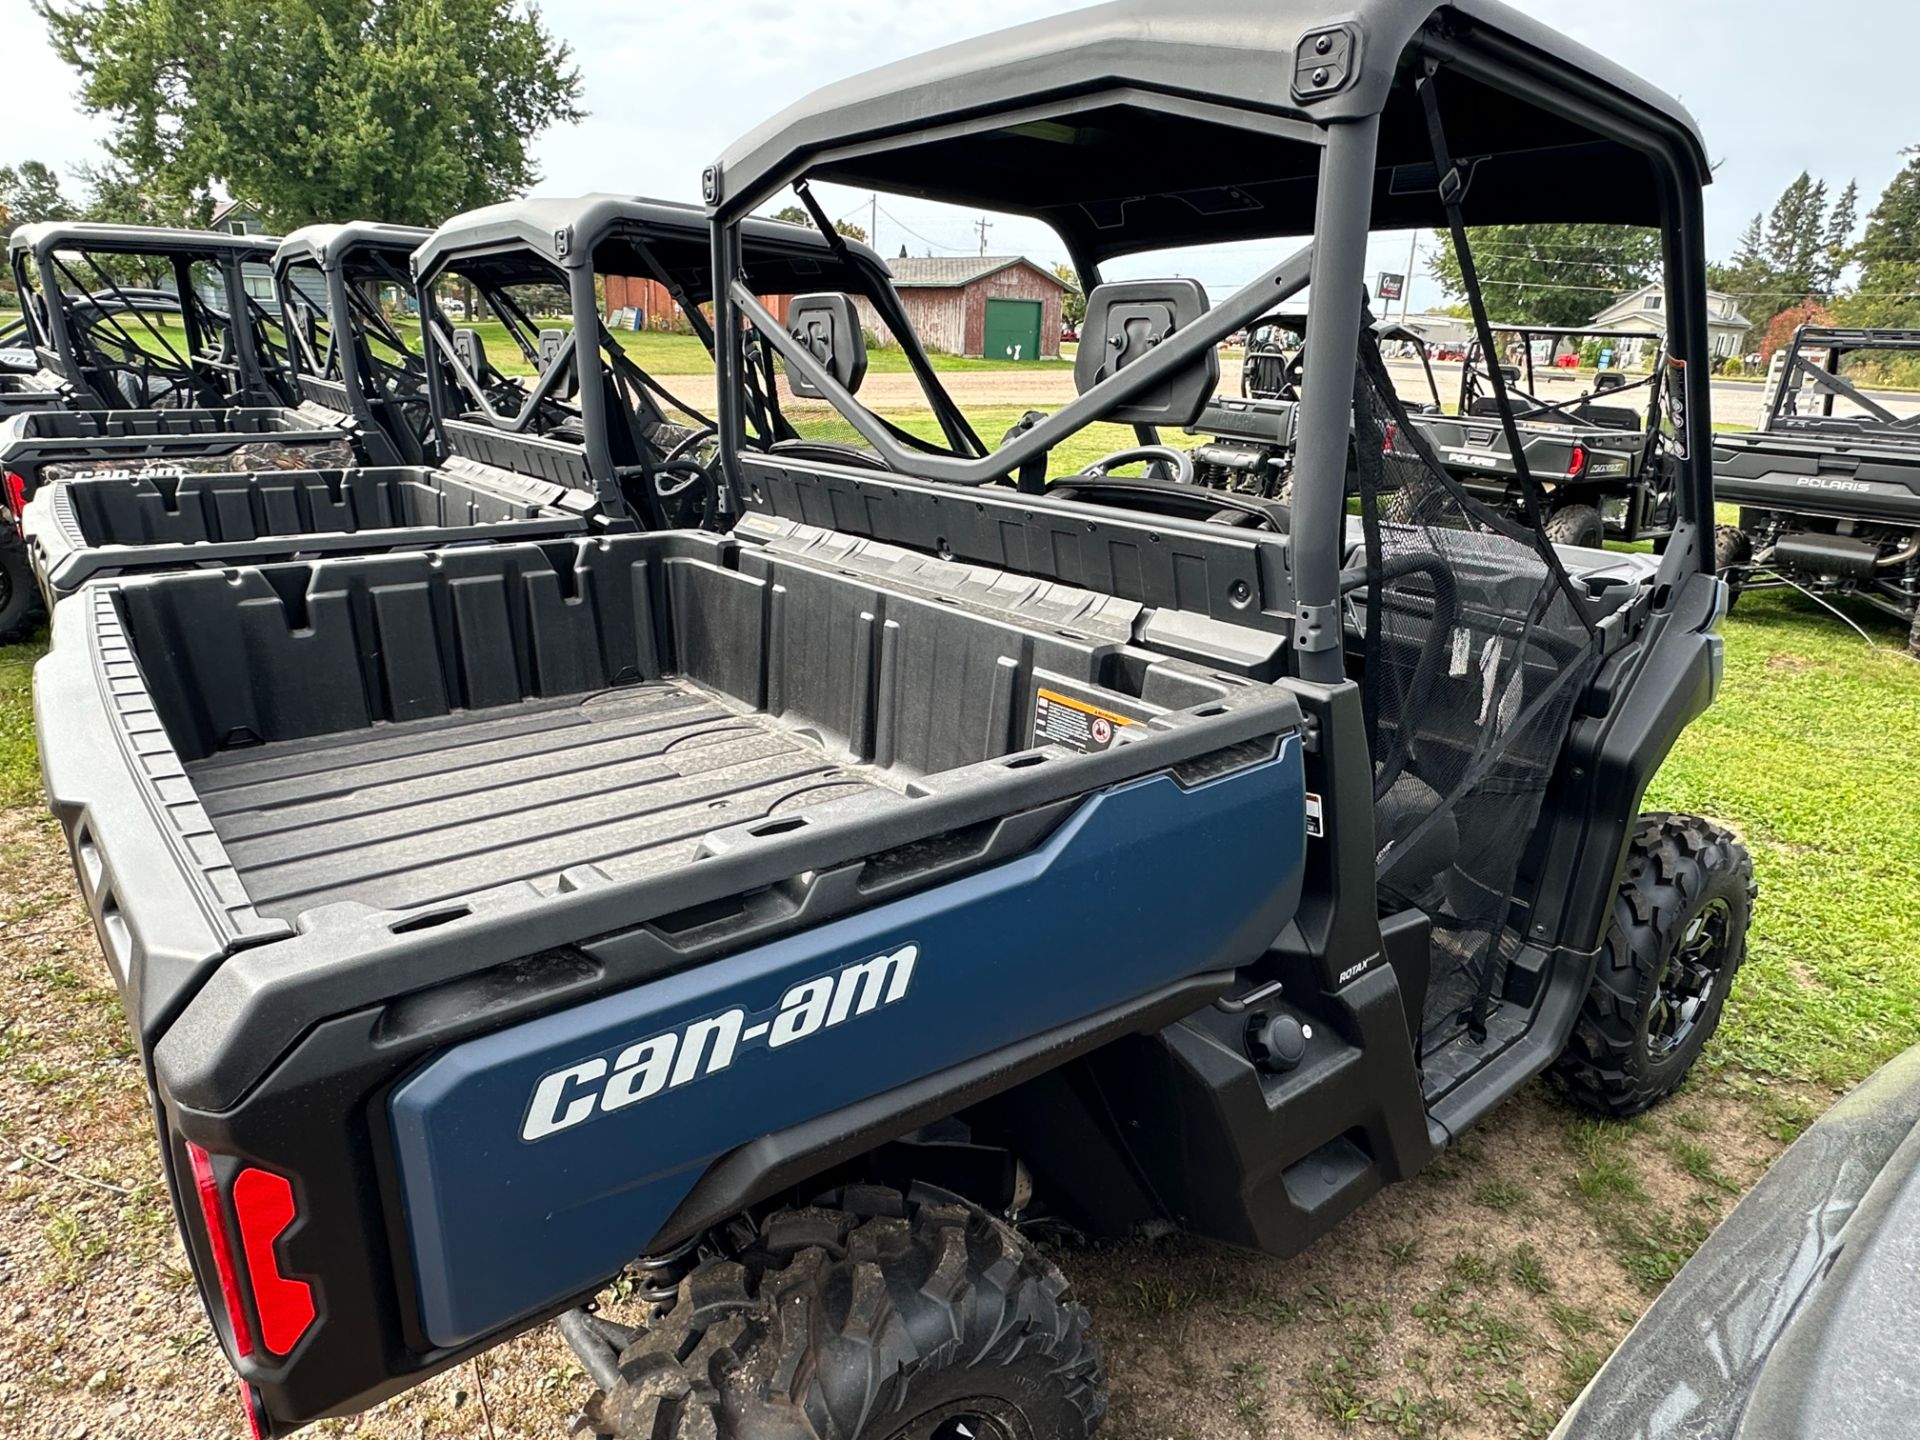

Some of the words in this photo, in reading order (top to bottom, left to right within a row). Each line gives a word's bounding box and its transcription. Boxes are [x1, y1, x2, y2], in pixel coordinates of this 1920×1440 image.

[1449, 453, 1497, 466] POLARIS
[1797, 478, 1870, 492] POLARIS
[1339, 959, 1368, 983] ROTAX
[523, 945, 917, 1140] can-am
